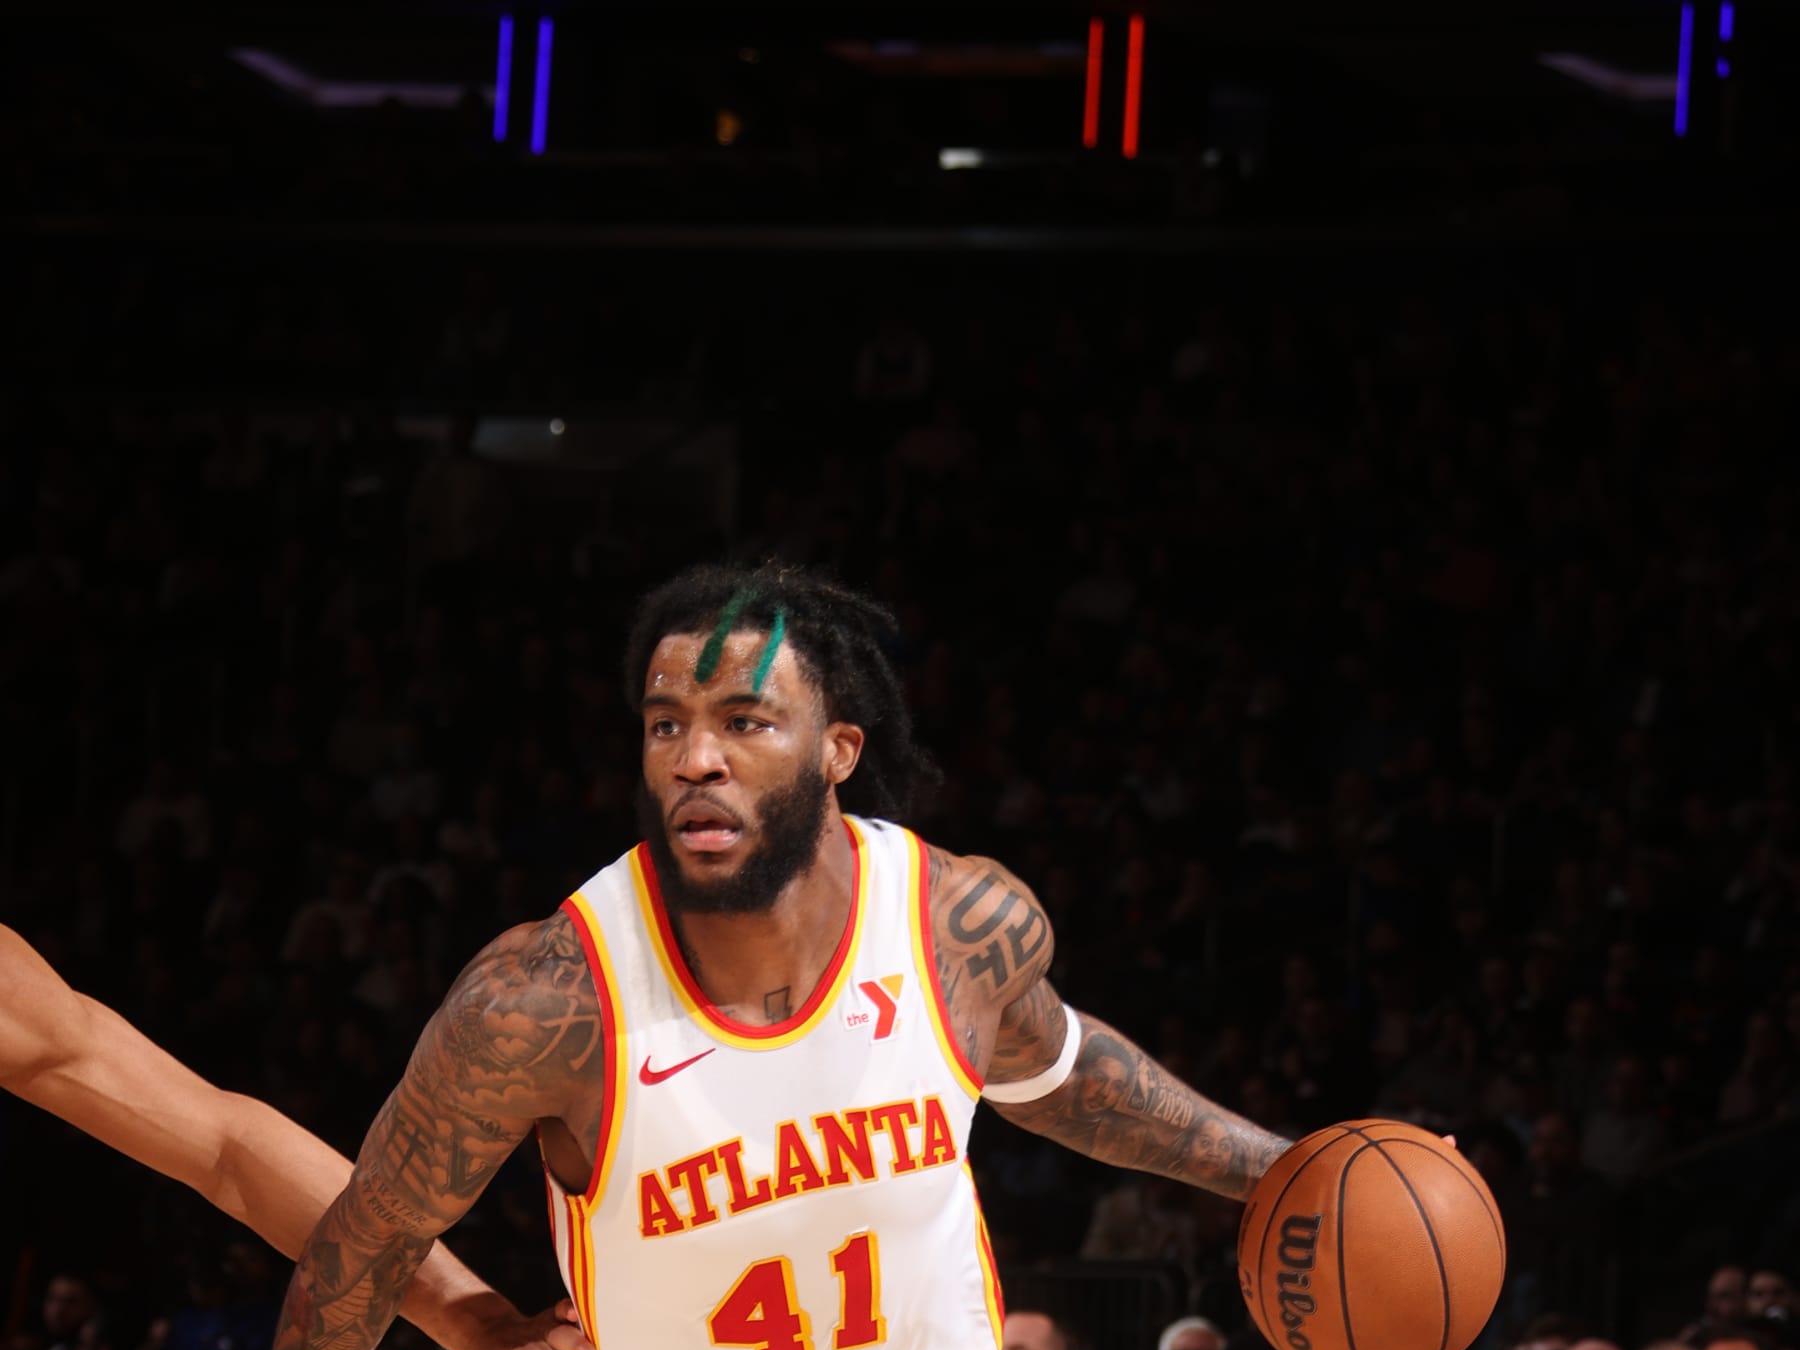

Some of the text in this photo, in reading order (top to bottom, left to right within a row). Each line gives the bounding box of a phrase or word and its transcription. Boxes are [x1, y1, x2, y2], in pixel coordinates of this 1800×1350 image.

[846, 1013, 869, 1027] the
[1152, 1088, 1193, 1129] 2020
[638, 1095, 957, 1239] ATLANTA
